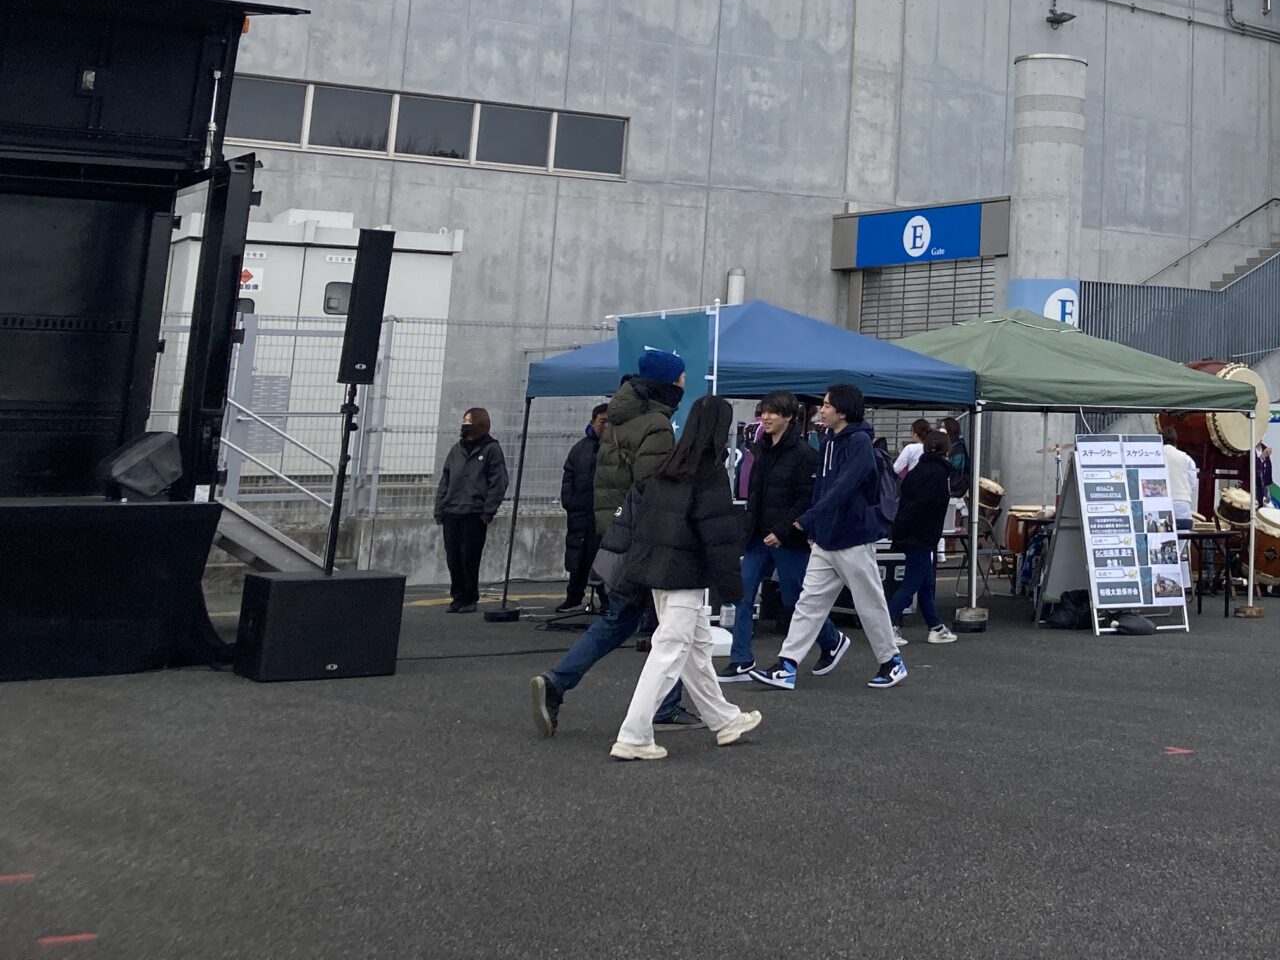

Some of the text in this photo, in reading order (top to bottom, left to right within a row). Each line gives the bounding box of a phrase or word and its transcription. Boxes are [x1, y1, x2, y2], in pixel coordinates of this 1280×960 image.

[910, 224, 925, 250] E
[931, 246, 945, 256] Gate
[1057, 298, 1075, 326] E
[1082, 449, 1161, 458] ステージカー スケジュール
